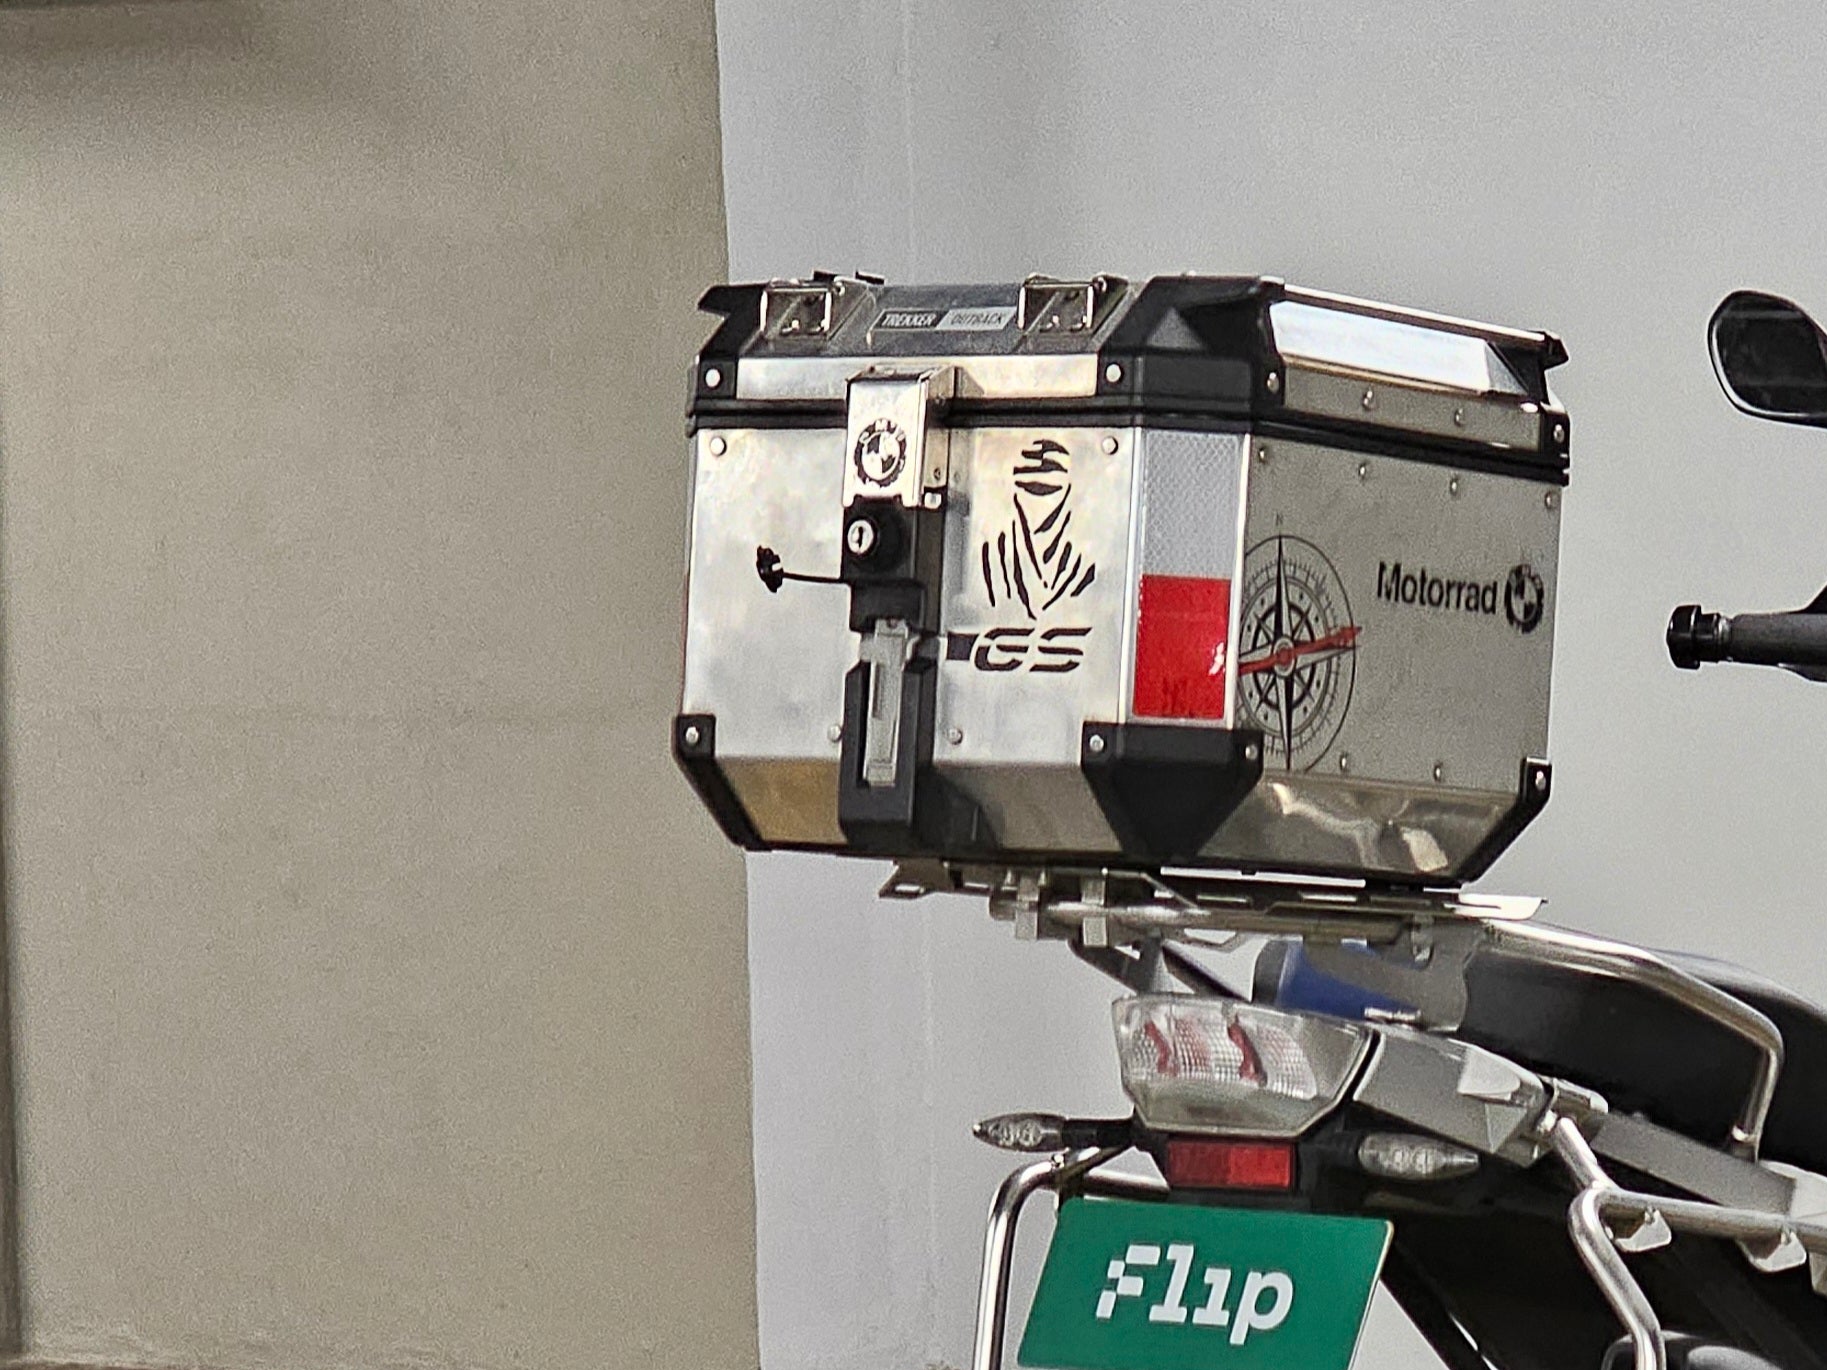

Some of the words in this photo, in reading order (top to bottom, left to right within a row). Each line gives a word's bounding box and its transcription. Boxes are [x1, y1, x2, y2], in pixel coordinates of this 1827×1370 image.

[881, 312, 938, 328] TREKKER
[1377, 560, 1498, 616] Motorrad
[974, 626, 1093, 673] GS
[1095, 1243, 1294, 1347] Flip
